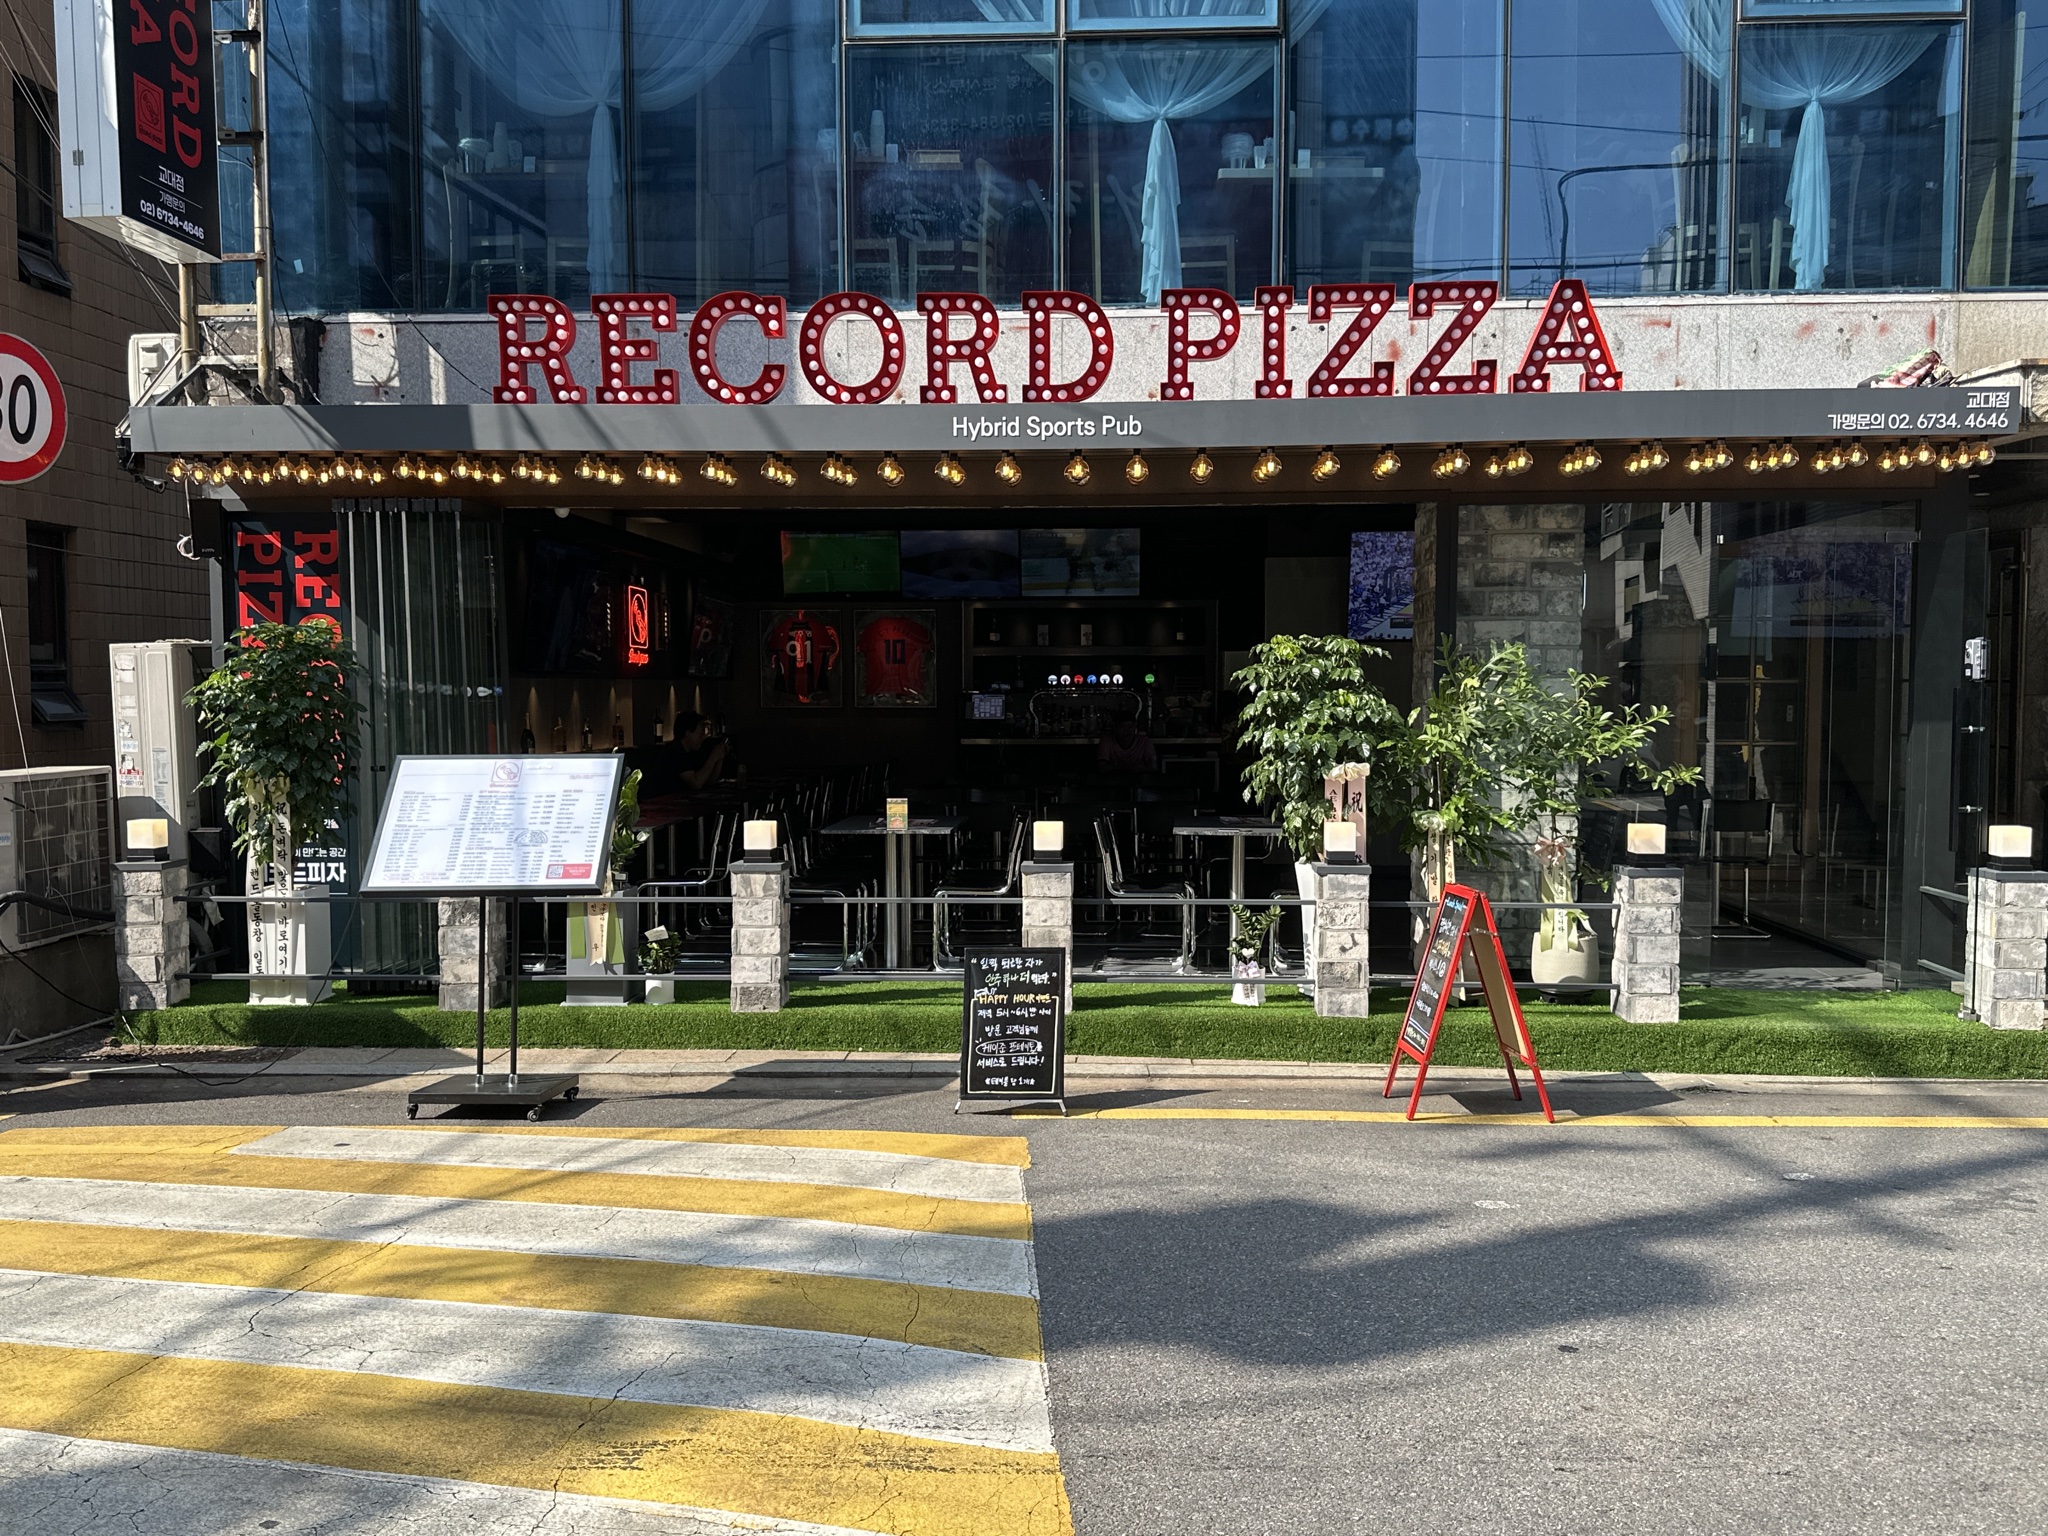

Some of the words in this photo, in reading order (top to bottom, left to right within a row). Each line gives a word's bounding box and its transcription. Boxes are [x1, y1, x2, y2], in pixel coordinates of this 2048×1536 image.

[169, 0, 203, 169] ORD
[159, 165, 185, 193] 교대점
[140, 200, 155, 217] 02)
[156, 207, 205, 239] 6734-4646
[487, 290, 1114, 404] RECORD
[1160, 279, 1623, 401] PIZZA
[0, 374, 37, 445] 0
[1966, 391, 2011, 409] 교대점
[952, 416, 1021, 441] Hybrid
[1027, 416, 1096, 438] Sports
[1102, 416, 1142, 436] Pub
[1827, 413, 1885, 430] 가맹문의
[1888, 413, 1914, 430] 02.
[1917, 413, 1961, 429] 6734.
[1964, 412, 2009, 429] 4646
[884, 639, 906, 664] 10
[275, 822, 288, 862] 돈벼락
[329, 847, 347, 857] 공간
[979, 994, 1008, 1005] HAPPY
[977, 1008, 993, 1019] 저녁
[996, 1008, 1009, 1018] 5시
[985, 1024, 1002, 1037] 방문
[976, 1057, 1007, 1069] 서비스로
